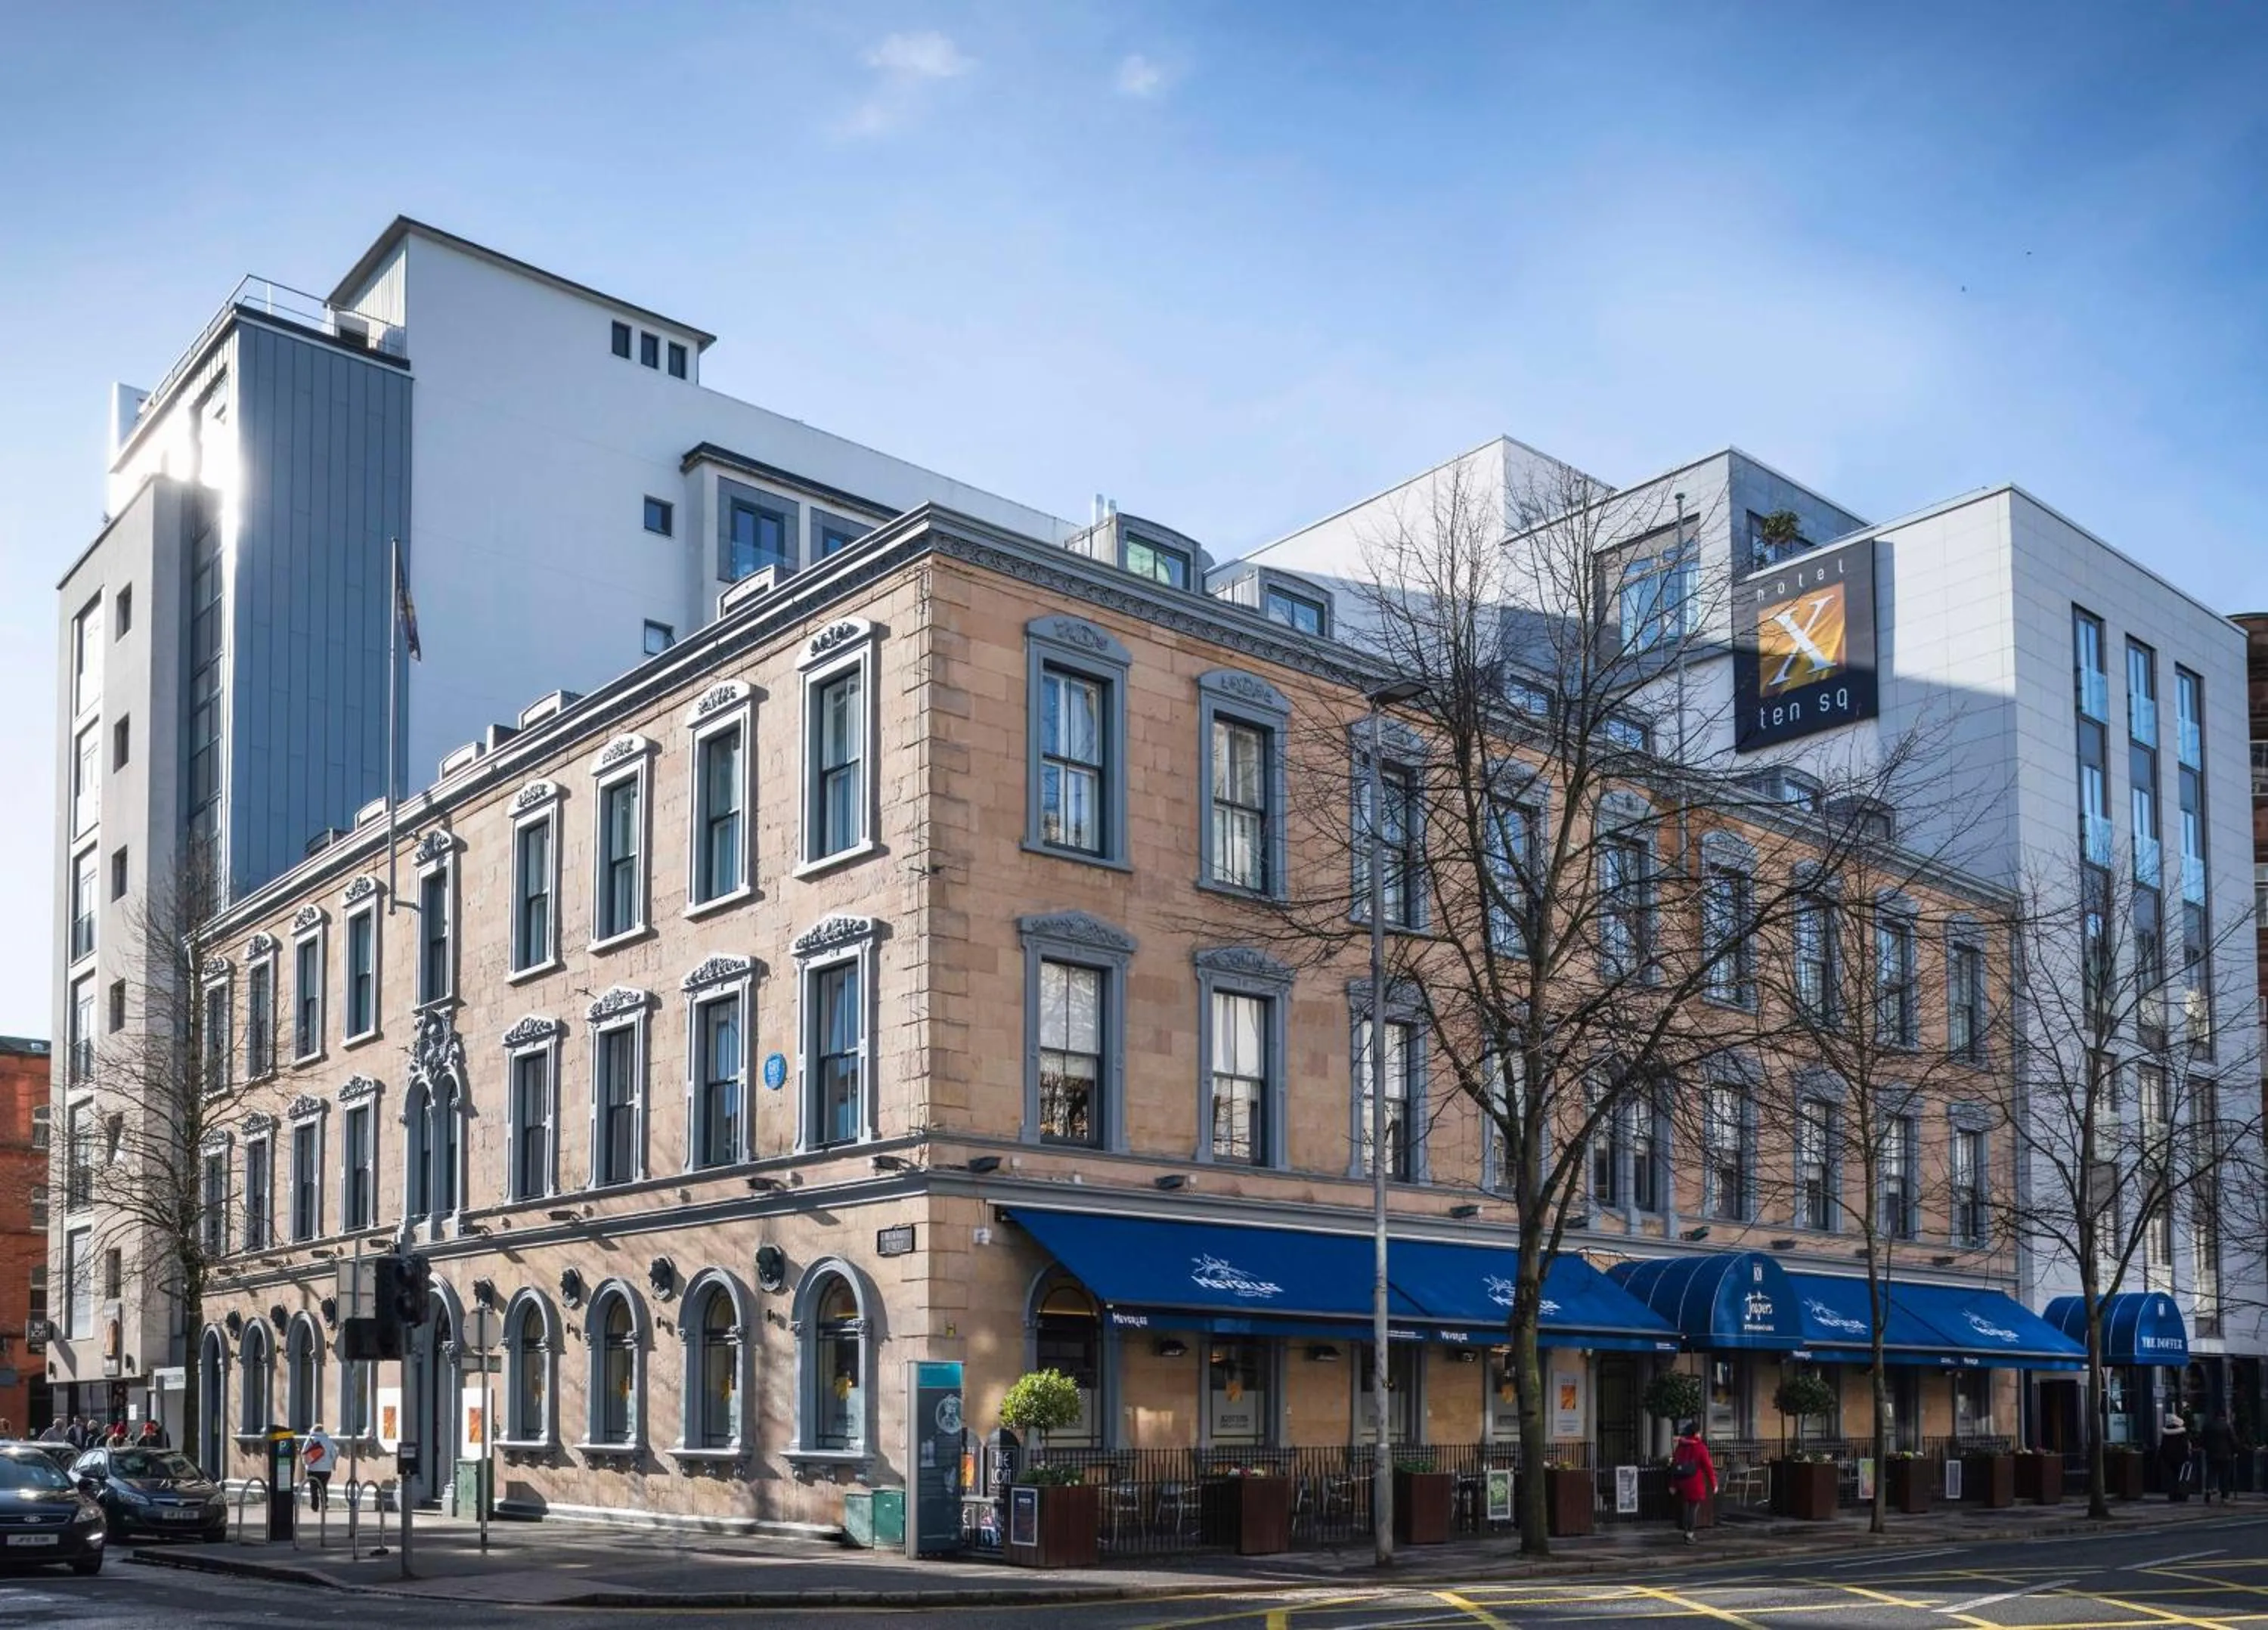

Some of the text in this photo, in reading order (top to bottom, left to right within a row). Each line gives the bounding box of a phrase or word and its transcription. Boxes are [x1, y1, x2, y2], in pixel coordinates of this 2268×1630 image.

[1769, 594, 1838, 686] X
[1760, 688, 1848, 730] ten sq
[279, 1440, 287, 1451] P
